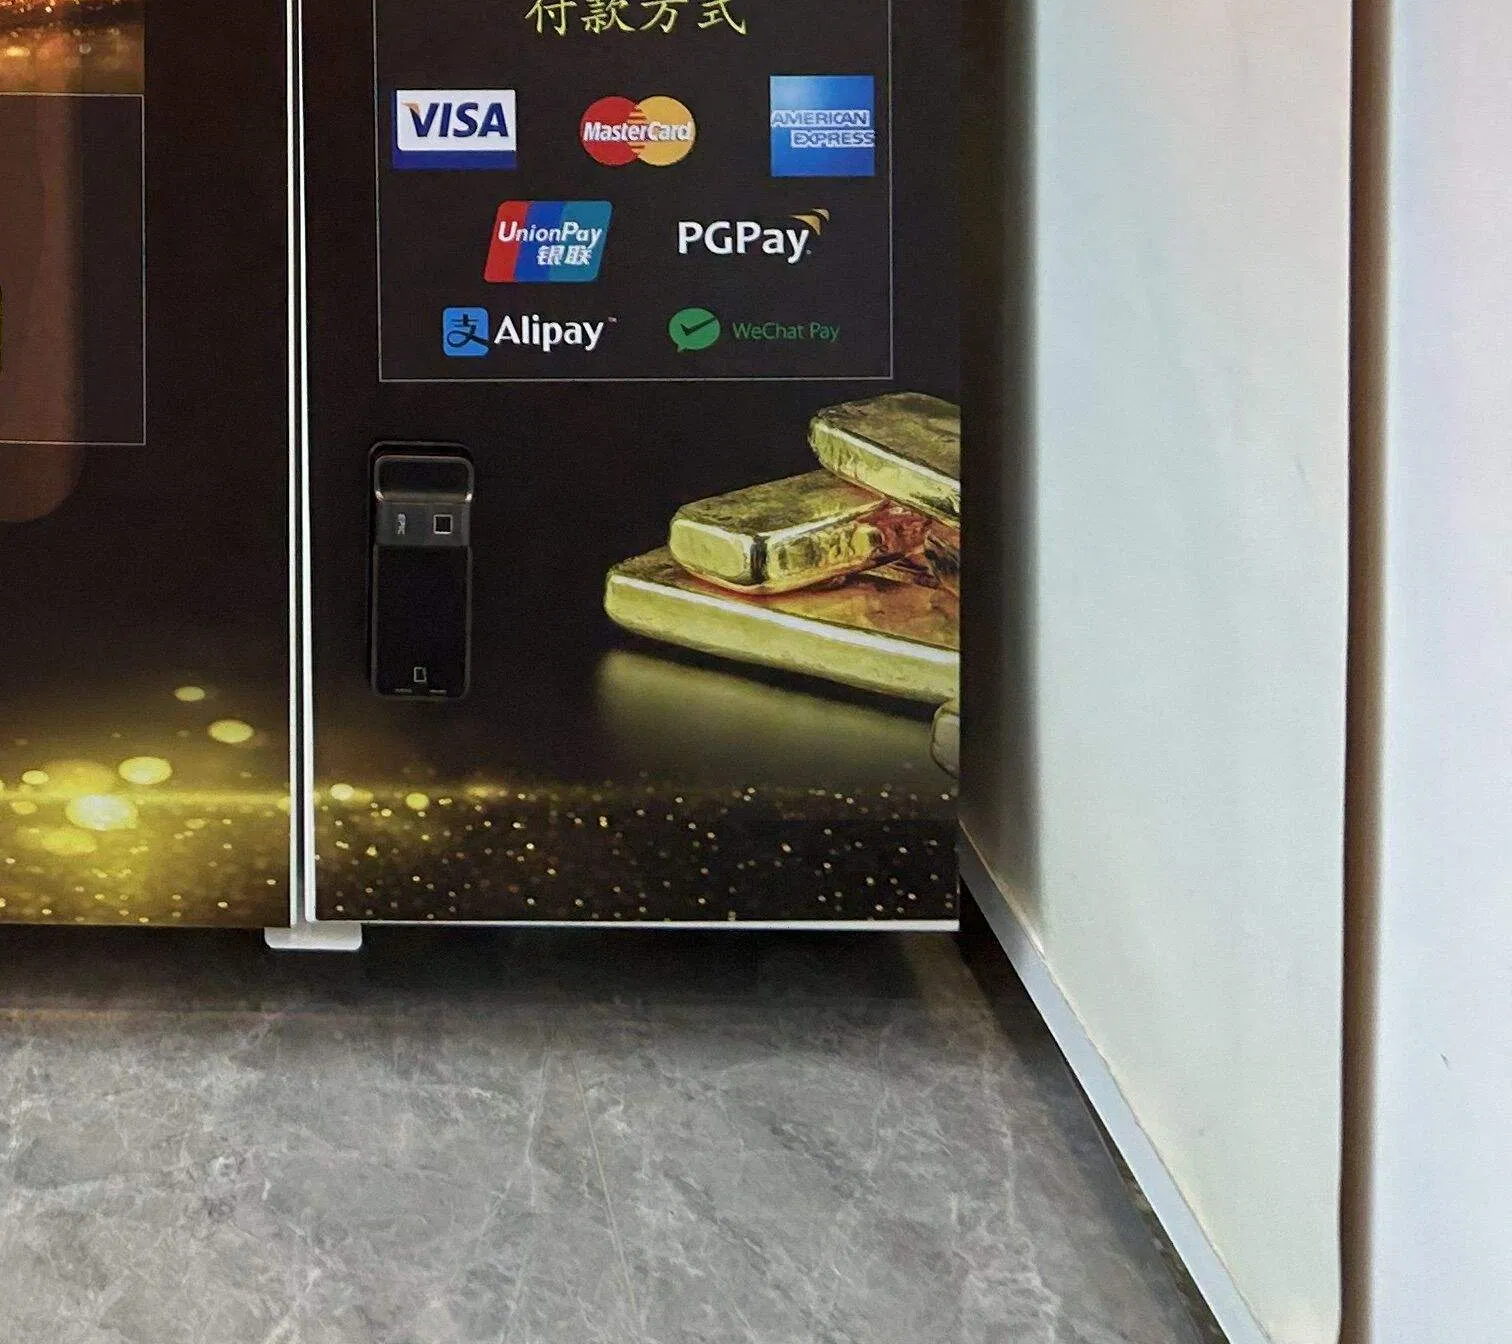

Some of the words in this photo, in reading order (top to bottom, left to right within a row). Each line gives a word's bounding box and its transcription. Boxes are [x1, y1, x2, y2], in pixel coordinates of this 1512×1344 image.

[403, 101, 510, 139] VISA
[772, 110, 869, 126] AMERICAN
[582, 121, 694, 143] MasterCard
[792, 131, 875, 146] EXPRESS
[498, 221, 603, 249] UnionPay
[678, 220, 810, 264] PGPay
[494, 314, 604, 352] Alipay
[732, 321, 804, 340] WeChat
[809, 321, 840, 343] Pay
